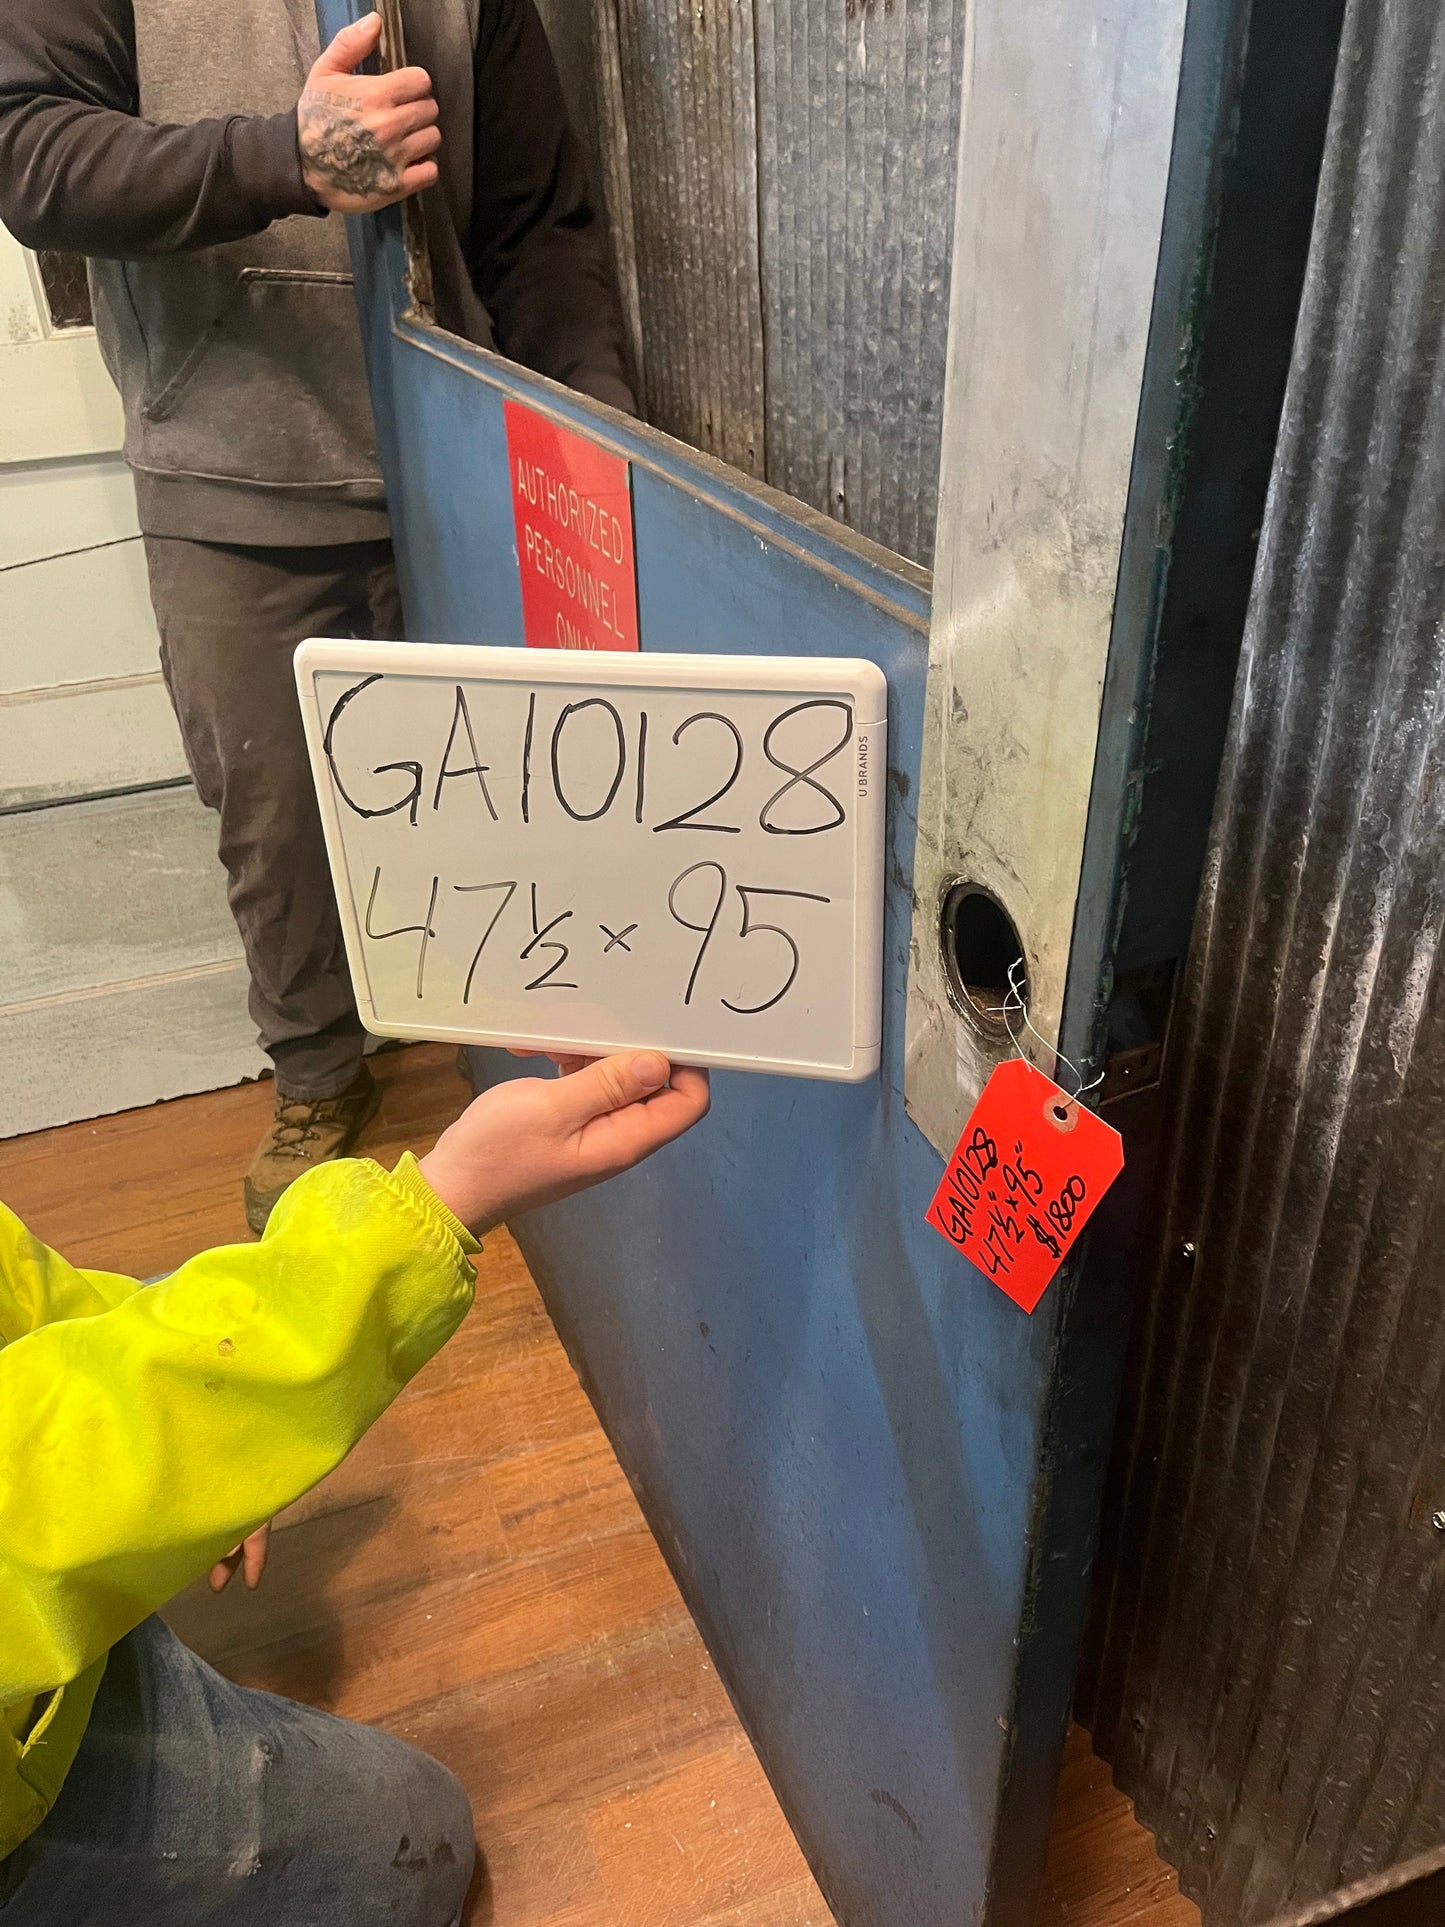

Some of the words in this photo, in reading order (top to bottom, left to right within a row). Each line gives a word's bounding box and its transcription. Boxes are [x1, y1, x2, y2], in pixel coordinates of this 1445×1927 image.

[517, 457, 624, 565] AUTHORIZED
[525, 524, 625, 639] PERSONNEL
[323, 673, 854, 835] GA10128
[858, 735, 868, 786] BRANDS
[858, 789, 868, 797] U
[667, 860, 831, 1014] 95
[936, 1127, 998, 1244] GA10128
[1026, 1175, 1086, 1259] $1800
